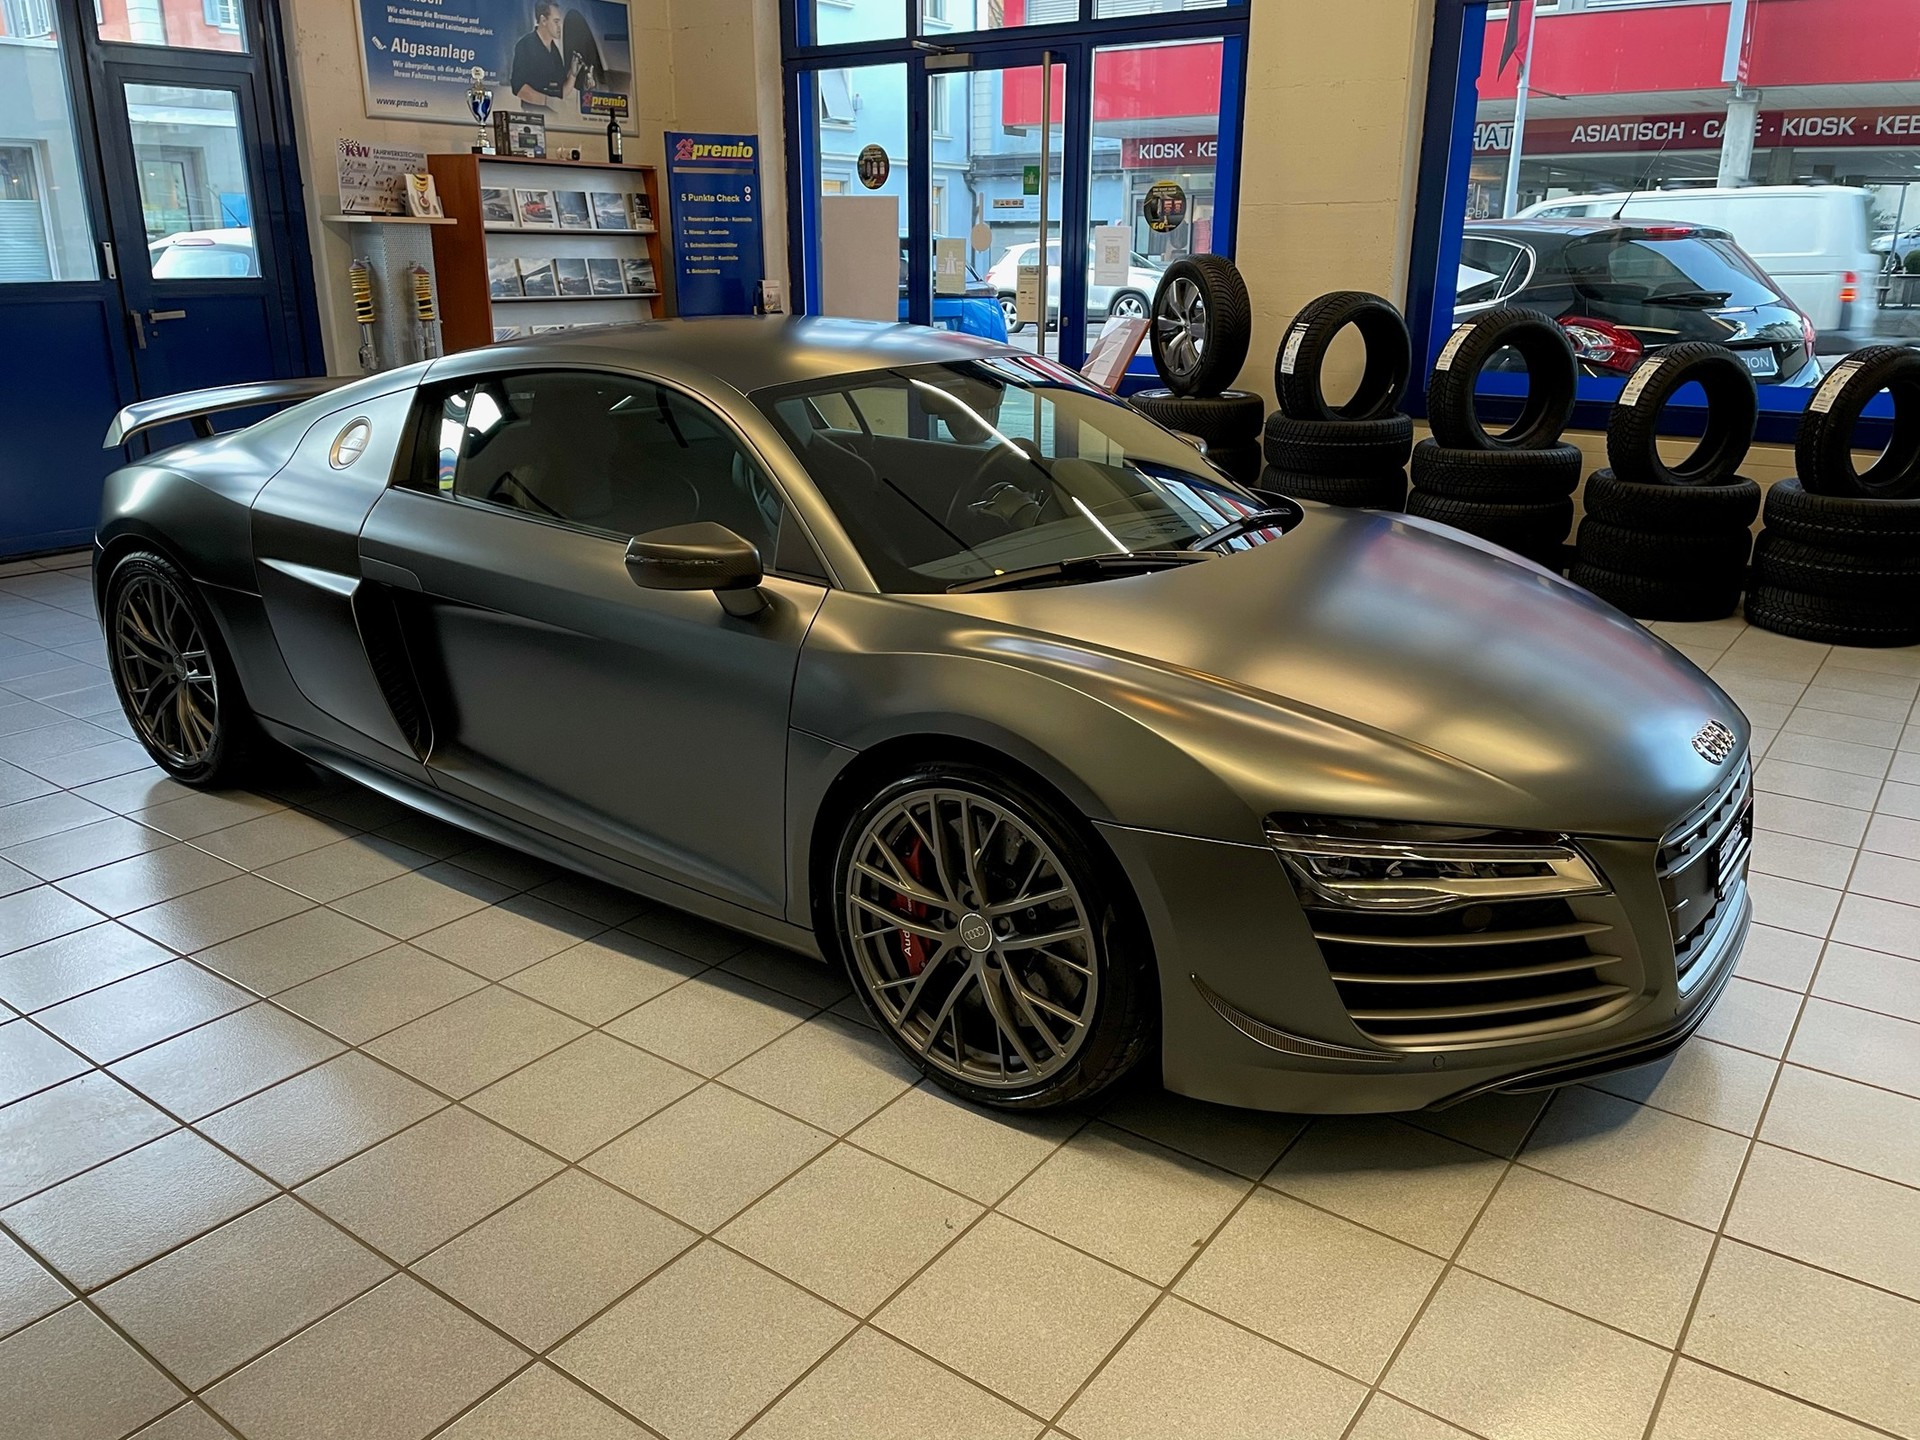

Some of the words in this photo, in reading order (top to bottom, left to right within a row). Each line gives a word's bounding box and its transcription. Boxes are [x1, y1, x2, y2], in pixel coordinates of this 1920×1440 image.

[387, 5, 398, 14] Wir
[399, 8, 423, 17] checken
[424, 10, 433, 18] die
[391, 37, 475, 62] Abgasanlage
[393, 60, 403, 68] Wir
[445, 65, 454, 73] die
[376, 97, 428, 108] www.premio.ch
[592, 96, 627, 107] premio
[1571, 121, 1685, 143] ASIATISCH
[1781, 116, 1857, 136] KIOSK
[345, 144, 370, 158] KW
[692, 142, 753, 160] premio
[1139, 143, 1185, 159] KIOSK
[680, 193, 687, 202] 5
[688, 193, 715, 202] Punkte
[716, 194, 740, 202] Check
[1741, 357, 1769, 368] ION
[903, 930, 912, 957] Aud
